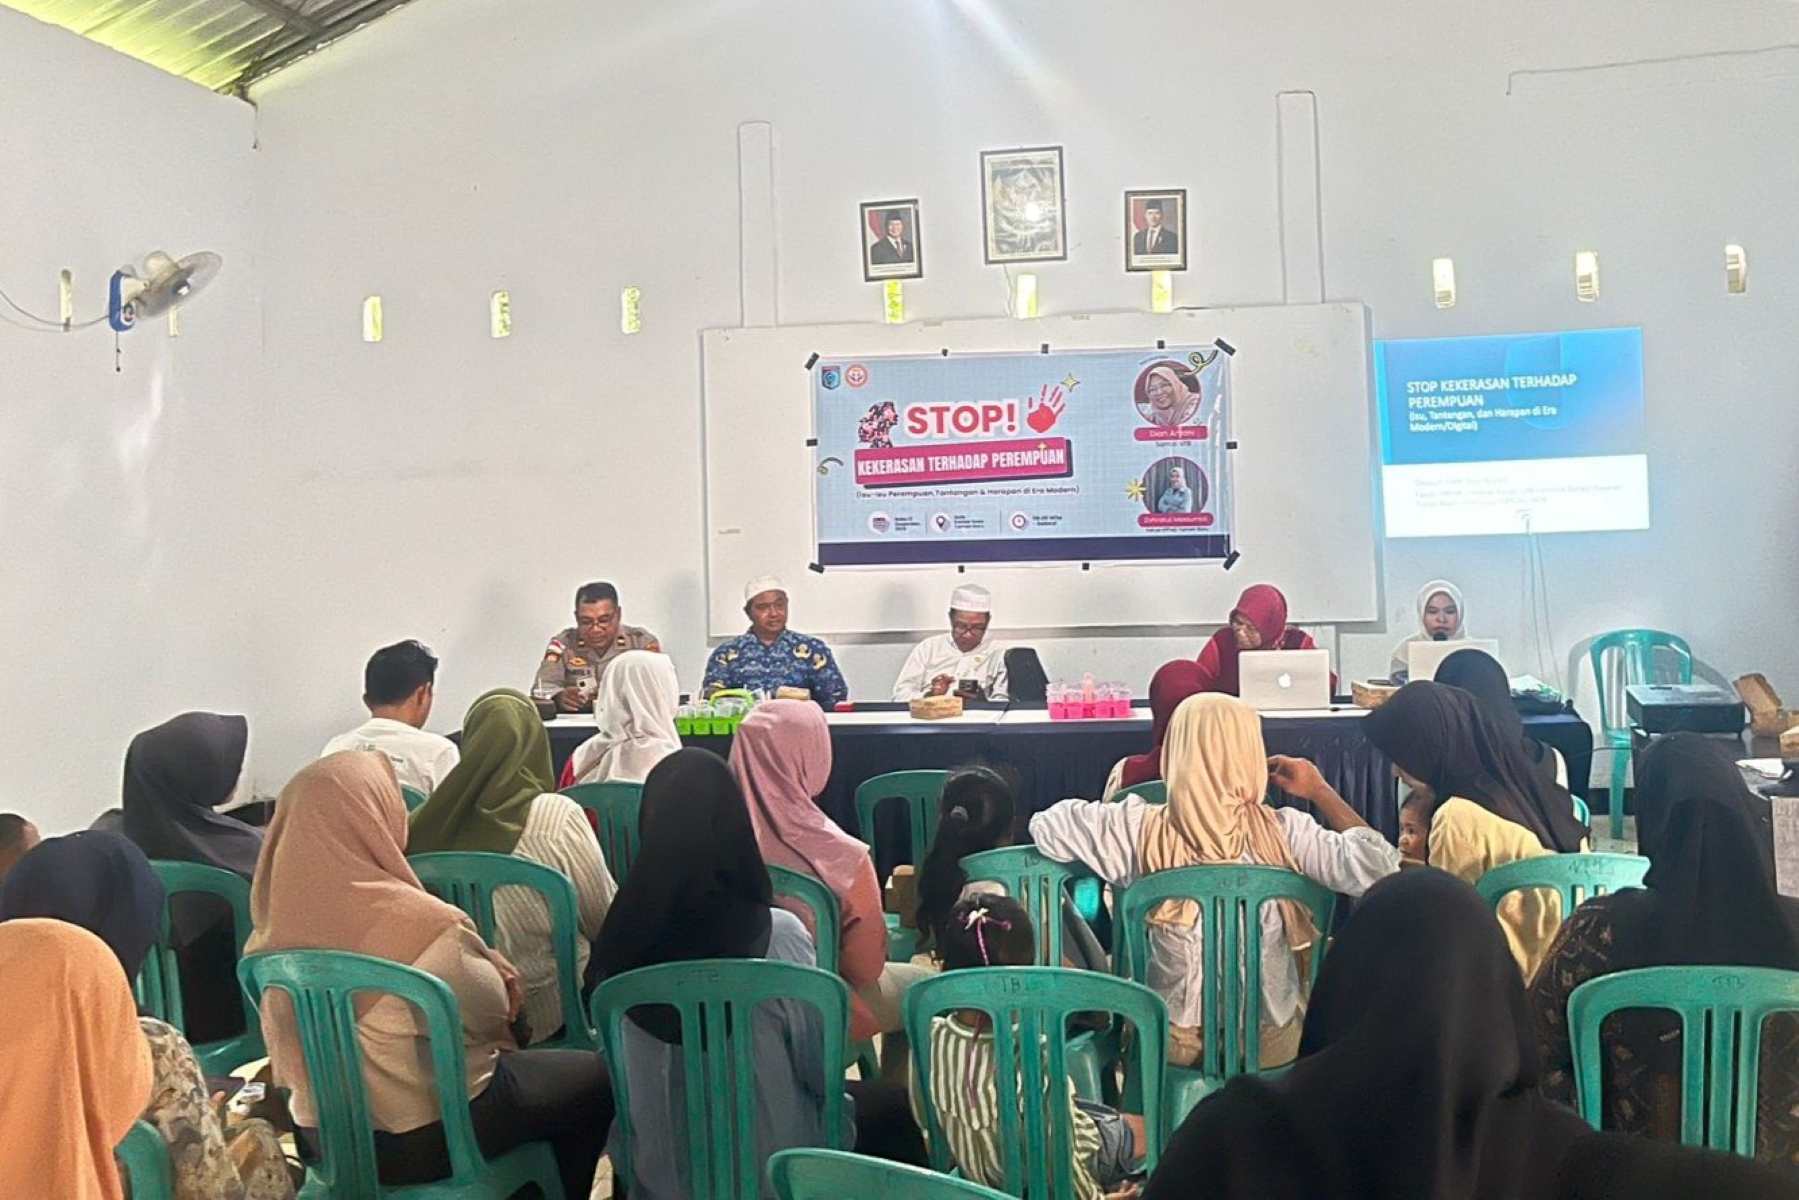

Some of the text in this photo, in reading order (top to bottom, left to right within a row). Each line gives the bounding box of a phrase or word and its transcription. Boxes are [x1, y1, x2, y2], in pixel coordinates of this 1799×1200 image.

[1407, 374, 1577, 393] STOP KEKERASAN TERHADAP
[1408, 395, 1484, 408] PEREMPUAN
[907, 403, 1015, 434] STOP!
[1476, 409, 1493, 418] dan
[1494, 407, 1531, 418] Harapan
[1532, 406, 1541, 416] di
[1542, 406, 1557, 416] Era
[857, 449, 1064, 476] KEKERASAN TERHADAP PEREMPUAN
